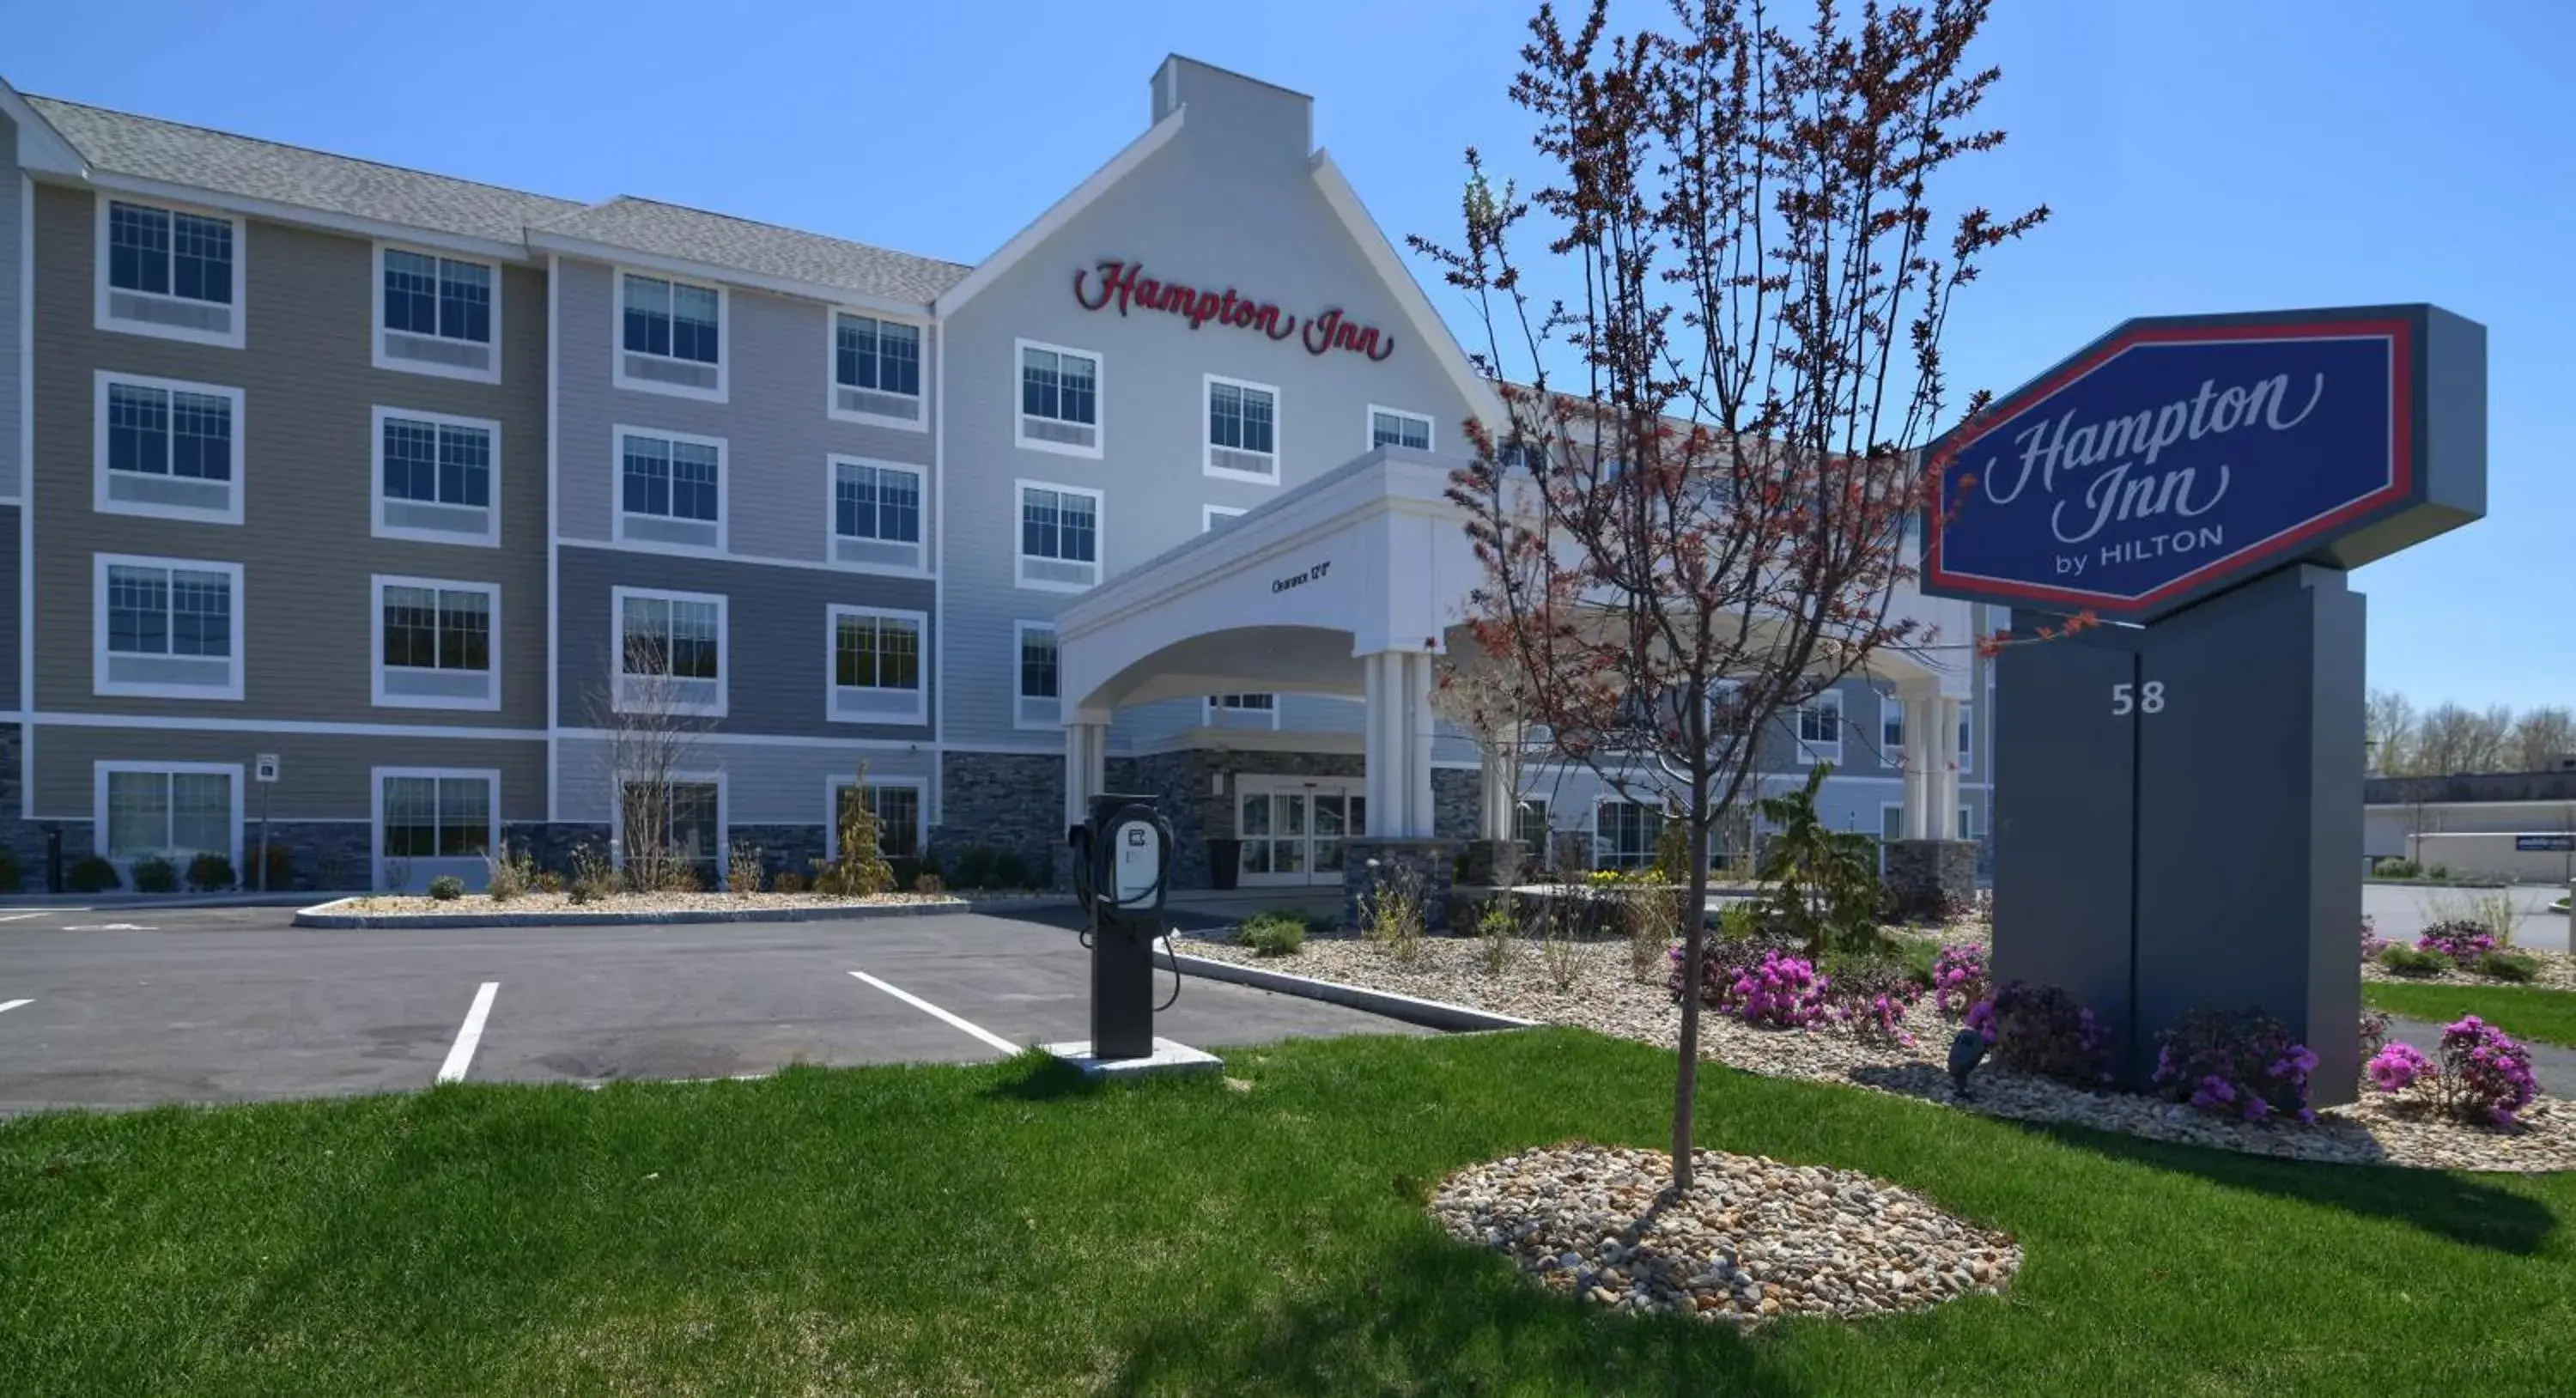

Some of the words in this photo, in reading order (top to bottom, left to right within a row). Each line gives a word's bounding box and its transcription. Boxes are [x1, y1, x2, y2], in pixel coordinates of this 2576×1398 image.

[1075, 259, 1296, 341] Hampton
[1303, 307, 1394, 362] Inn
[1984, 372, 2324, 505] Hampton
[2050, 462, 2230, 544] Inn
[2056, 554, 2087, 577] by
[2100, 525, 2224, 567] HILTON
[2111, 681, 2165, 715] 58
